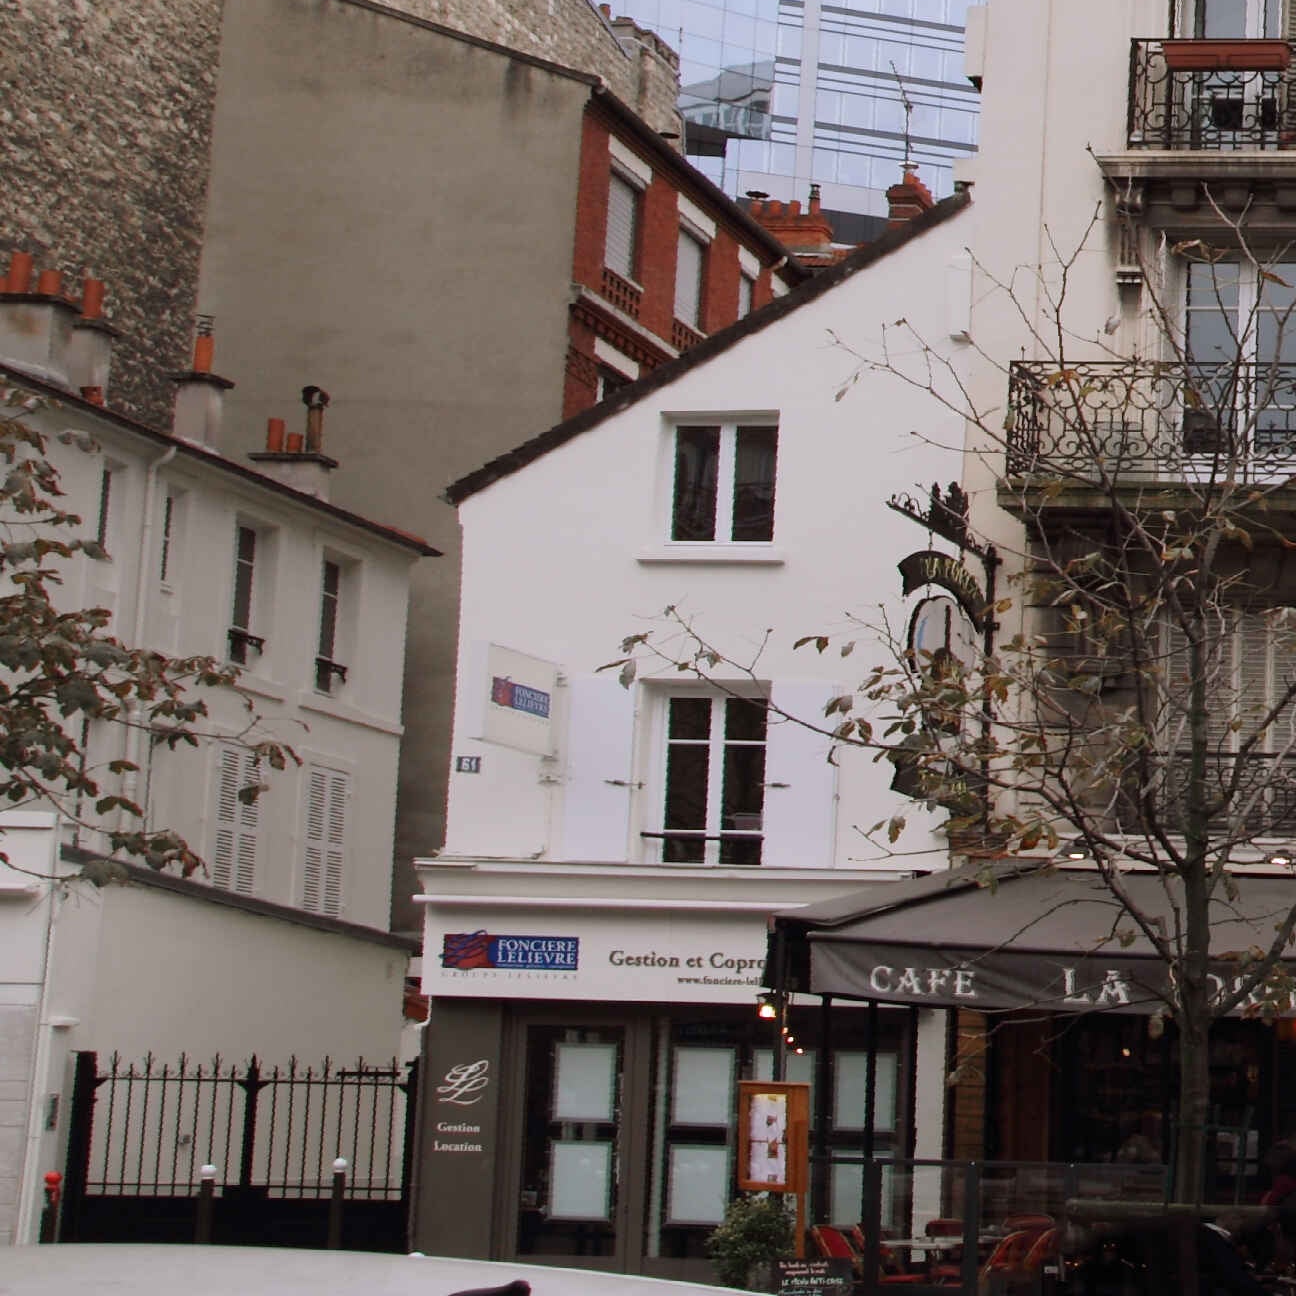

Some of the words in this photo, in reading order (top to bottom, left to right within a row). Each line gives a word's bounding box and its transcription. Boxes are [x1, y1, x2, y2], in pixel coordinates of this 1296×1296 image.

[498, 939, 577, 952] FONCIERE
[497, 952, 577, 965] LELIEVRE
[608, 950, 681, 968] Gestion
[686, 954, 703, 969] et
[437, 1122, 481, 1134] Gestion
[434, 1140, 483, 1152] Location
